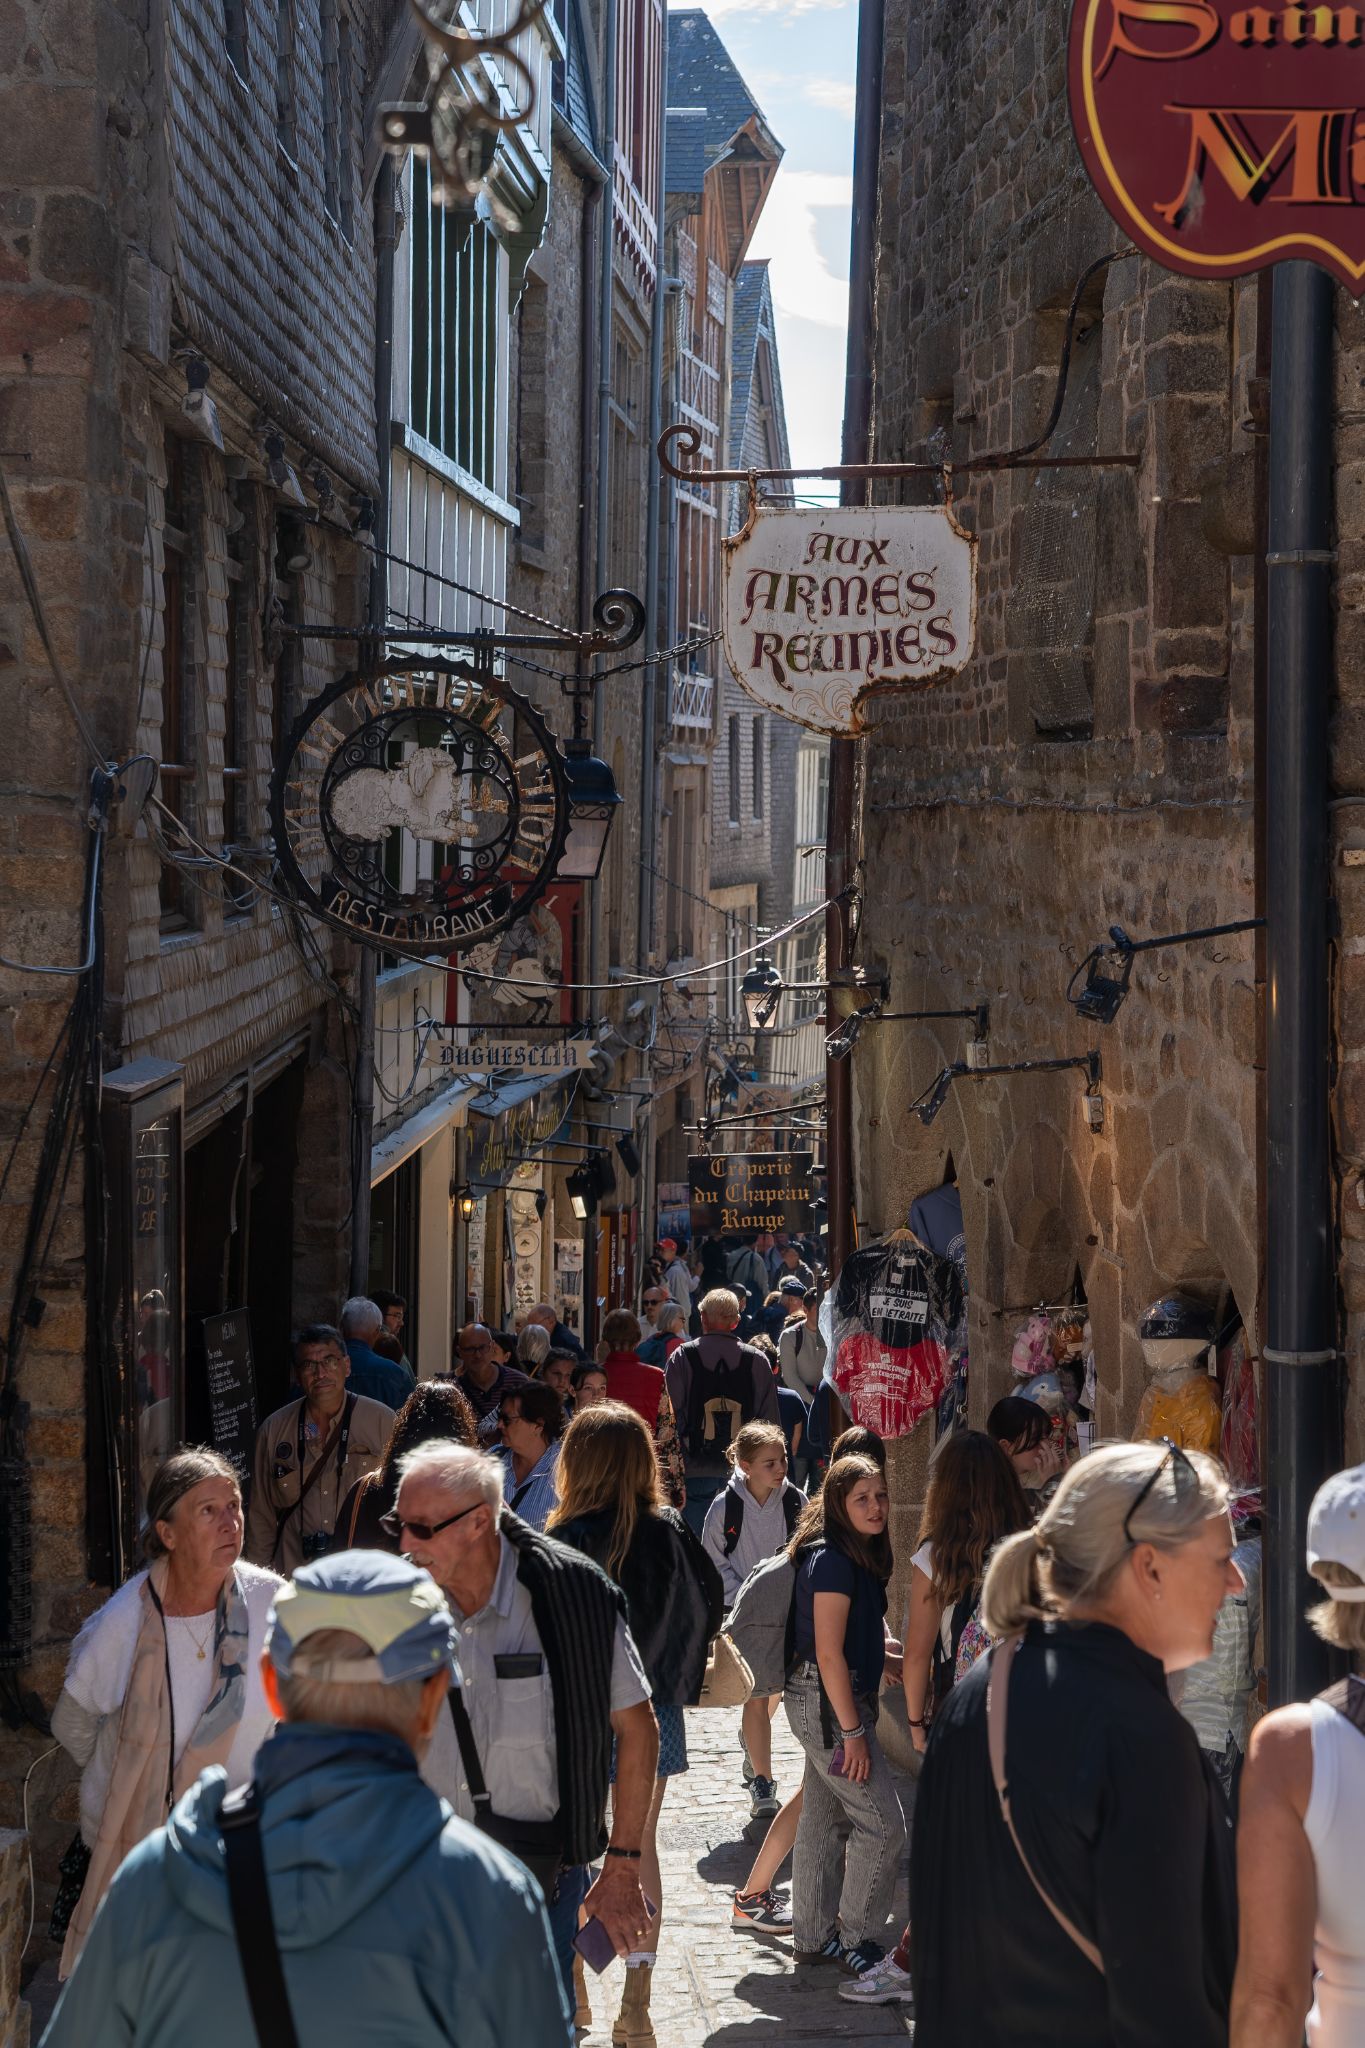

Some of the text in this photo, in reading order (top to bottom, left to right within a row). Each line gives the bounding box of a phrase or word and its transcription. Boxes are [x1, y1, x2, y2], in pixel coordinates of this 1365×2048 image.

[803, 532, 890, 571] AUX
[740, 566, 938, 624] ARMES
[327, 889, 496, 941] RESTAURANT
[694, 1183, 811, 1208] du Chapeau
[720, 1208, 786, 1234] Rouge
[872, 1307, 926, 1322] EN ETRAITE
[883, 1297, 914, 1310] JE SUIS
